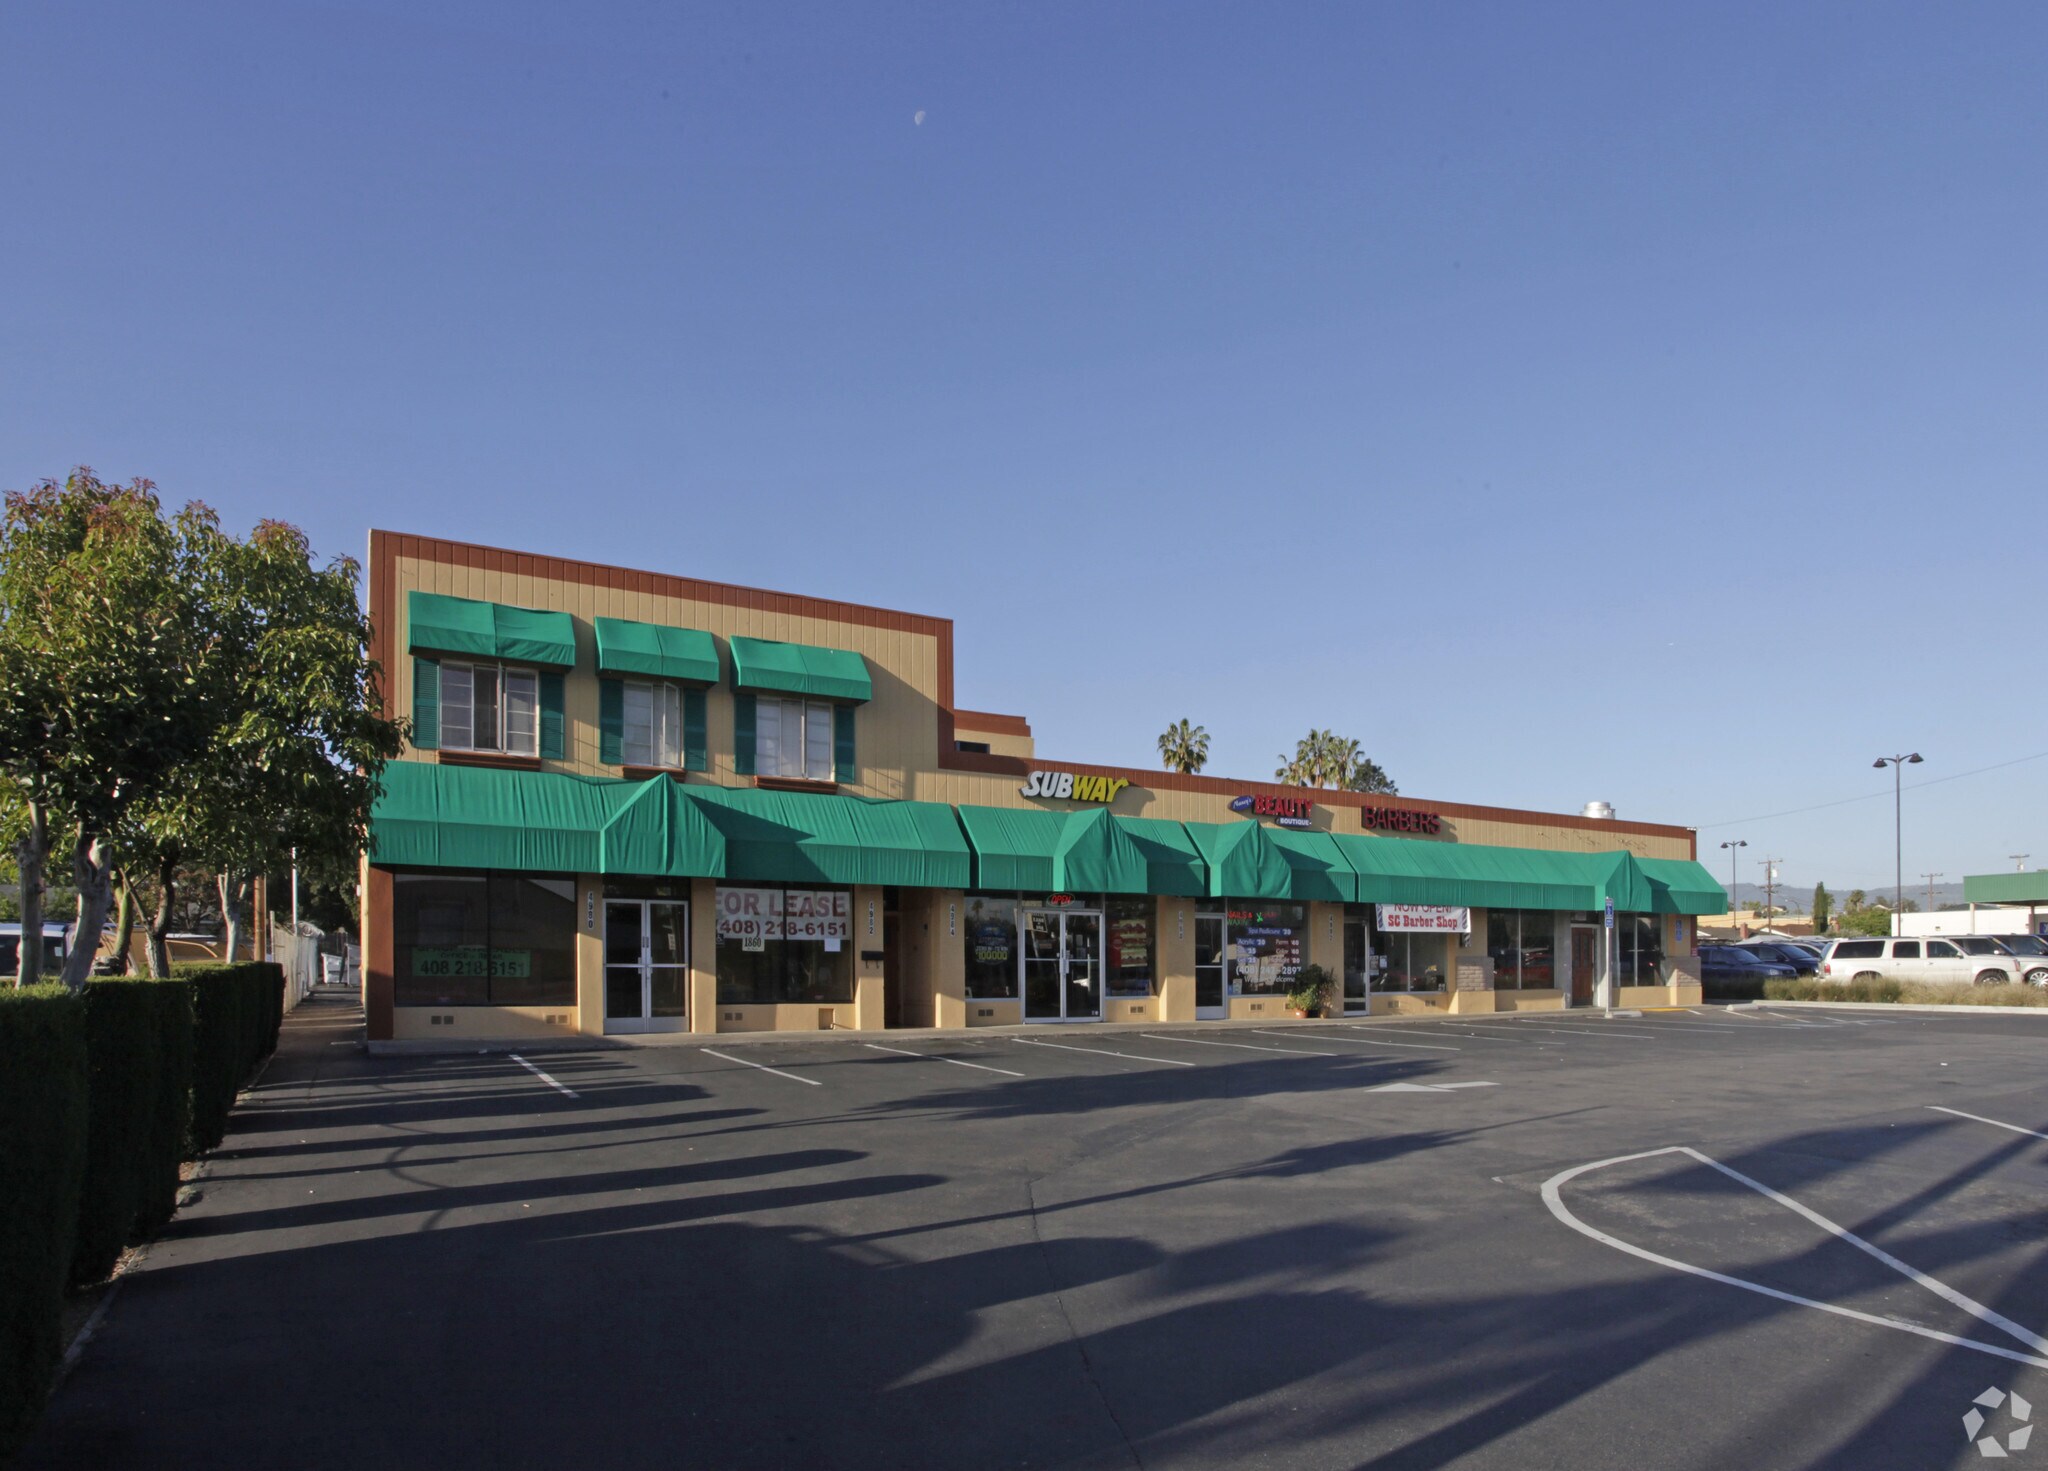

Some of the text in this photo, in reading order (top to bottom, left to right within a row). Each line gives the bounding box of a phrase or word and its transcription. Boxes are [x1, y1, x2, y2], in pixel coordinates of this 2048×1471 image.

[1020, 770, 1130, 803] SUBWAY
[1254, 793, 1314, 818] BEAUTY
[1279, 817, 1311, 827] BOUTIQUE
[1362, 804, 1442, 836] BARBERS
[768, 893, 847, 918] LEASE
[1050, 895, 1072, 905] OPEN
[1394, 904, 1420, 913] NOW
[716, 918, 847, 938] (408) 218-6151
[1388, 914, 1458, 930] SC Barber Shop
[420, 960, 525, 976] 408 218-6151
